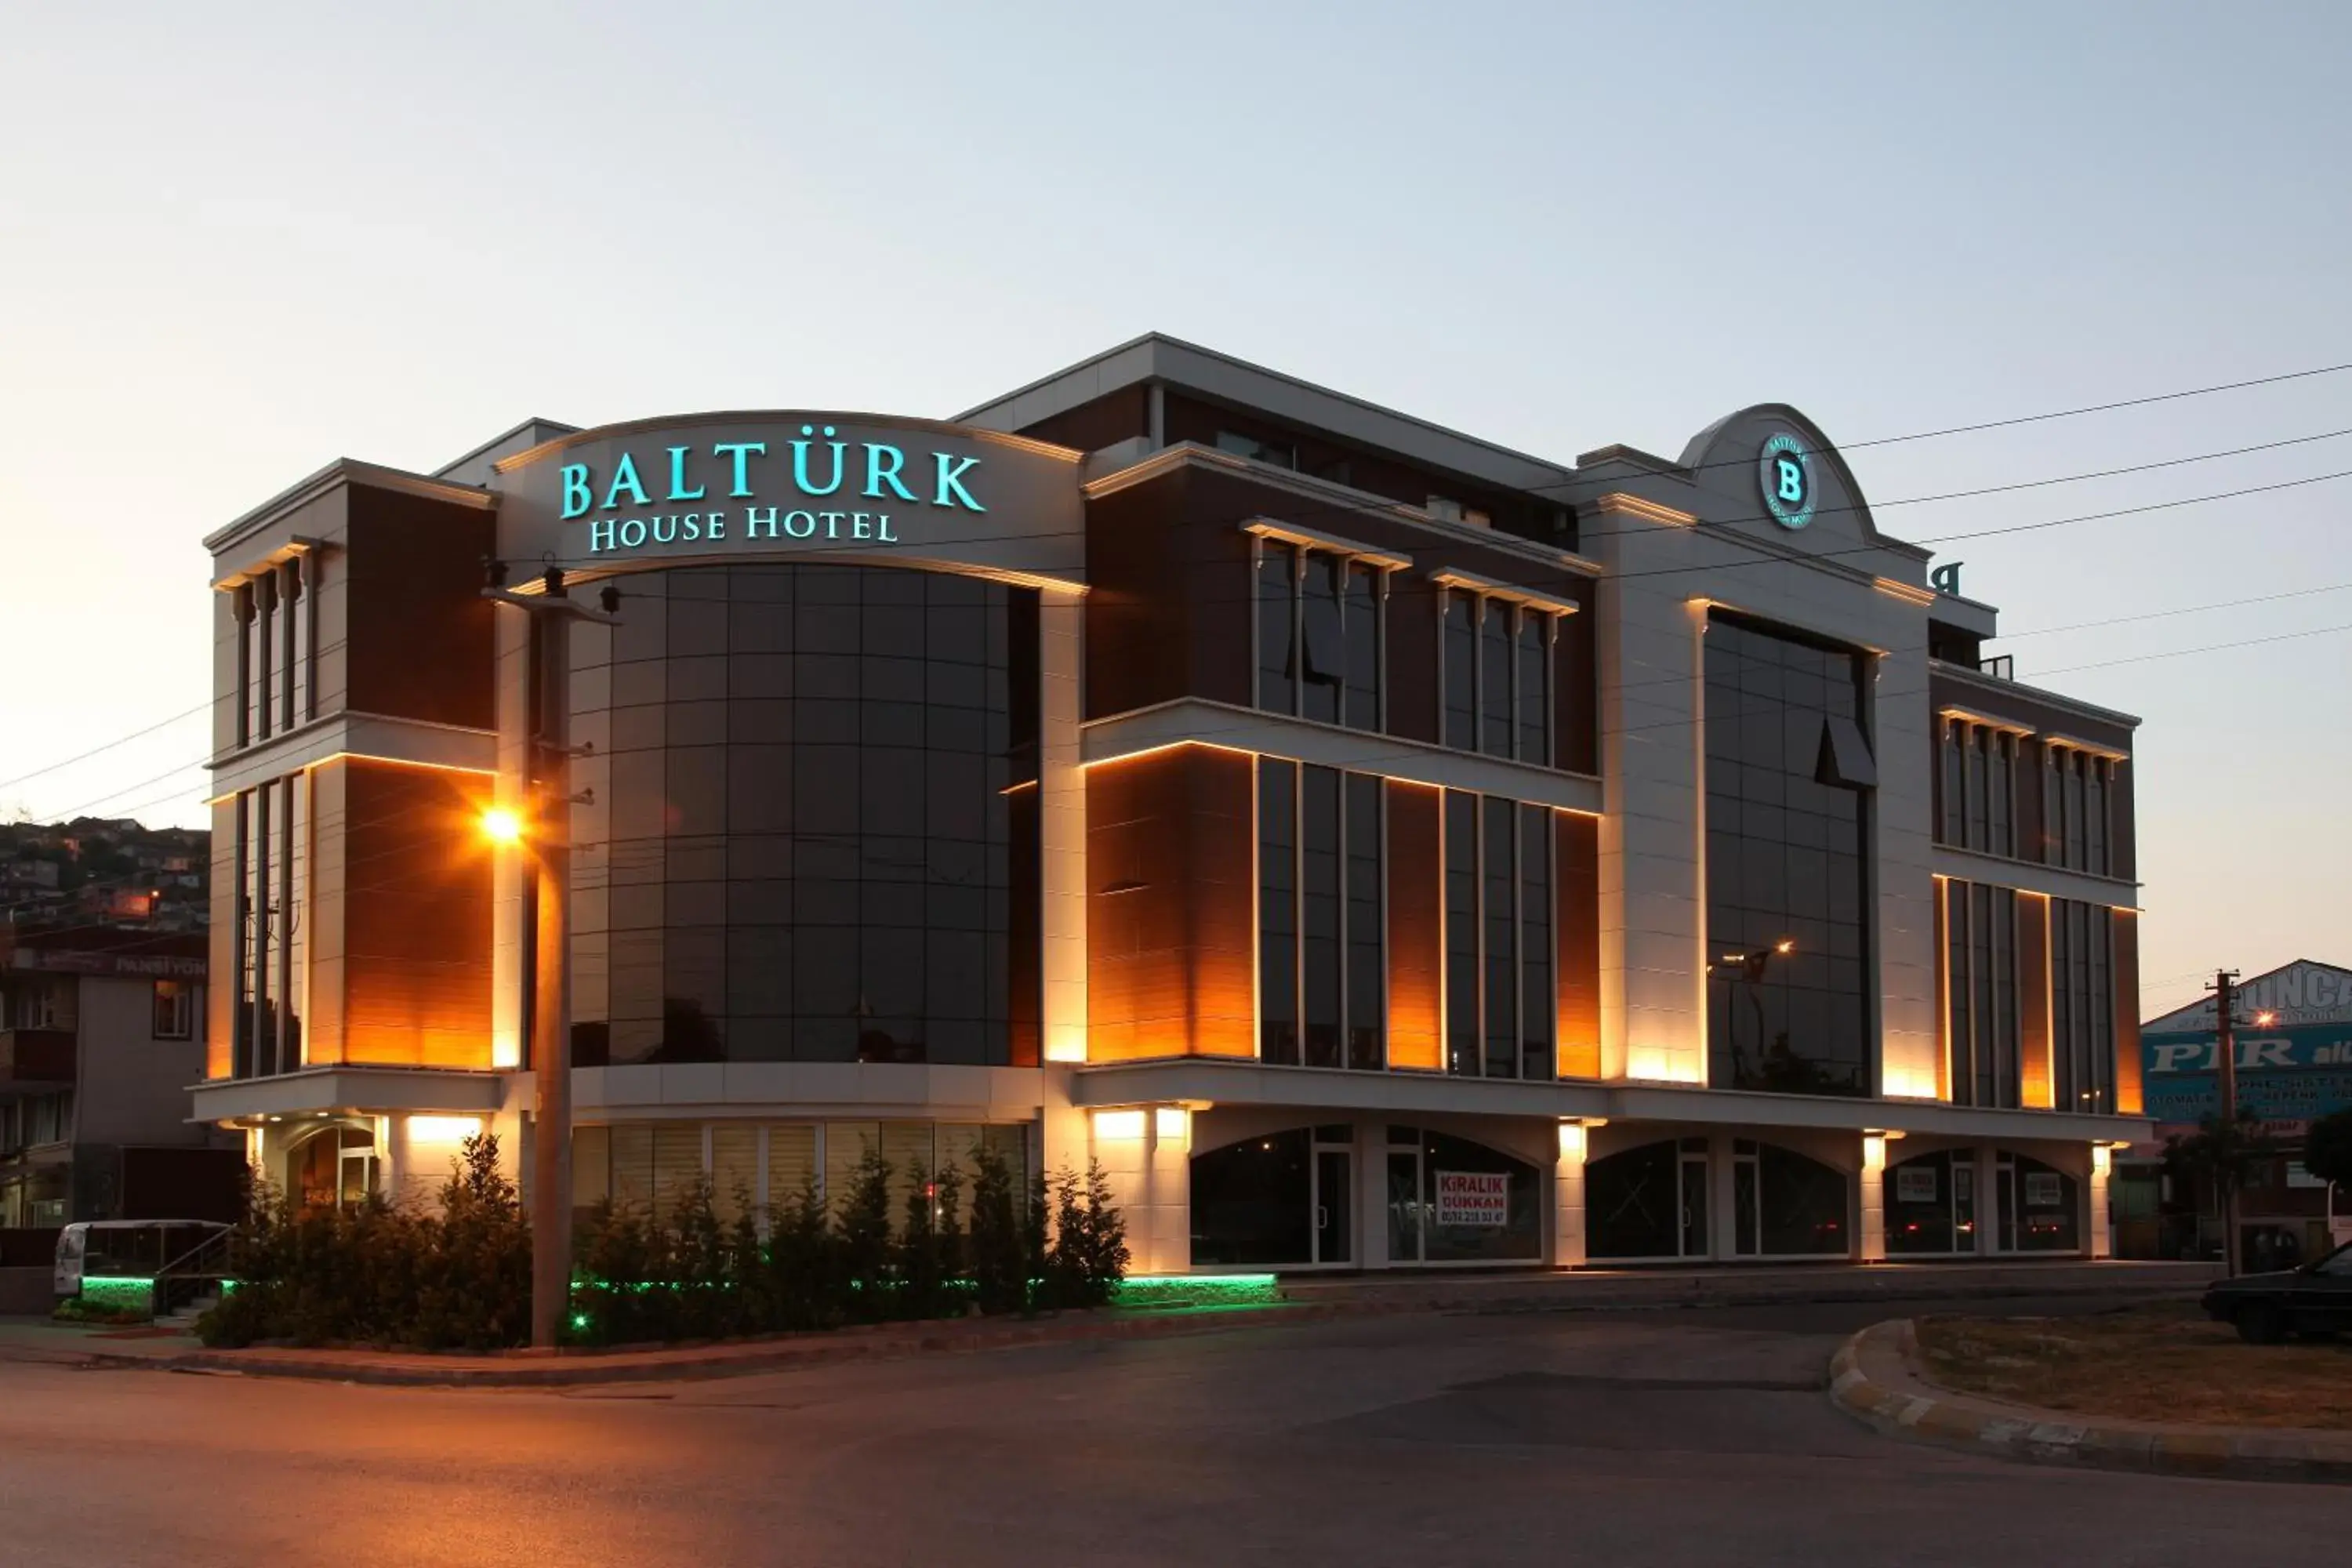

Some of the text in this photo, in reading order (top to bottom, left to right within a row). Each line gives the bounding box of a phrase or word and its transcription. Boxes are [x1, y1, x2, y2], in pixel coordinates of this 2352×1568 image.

[560, 424, 988, 520] BALTÜRK
[1777, 459, 1802, 502] B
[590, 506, 898, 551] HOUSE HOTEL
